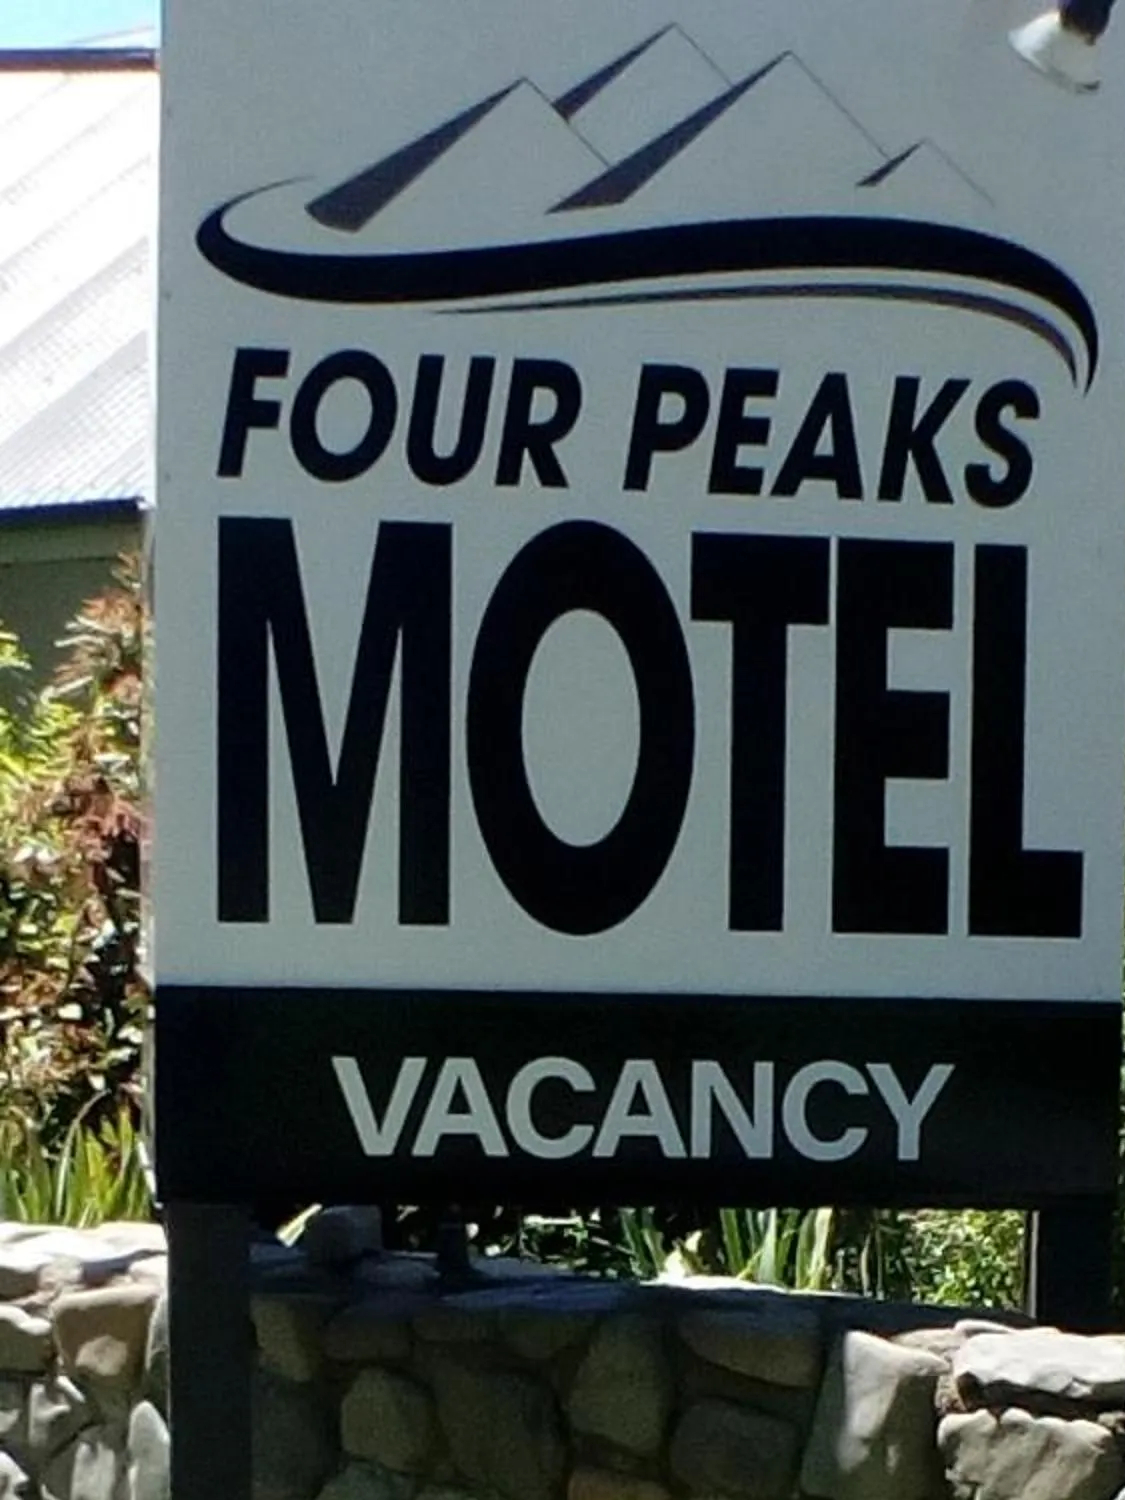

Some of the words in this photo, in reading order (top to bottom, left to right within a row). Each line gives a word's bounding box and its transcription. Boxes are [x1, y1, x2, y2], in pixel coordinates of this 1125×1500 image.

[216, 348, 581, 488] FOUR
[622, 364, 1040, 508] PEAKS
[217, 516, 1083, 938] MOTEL
[331, 1055, 955, 1161] VACANCY
